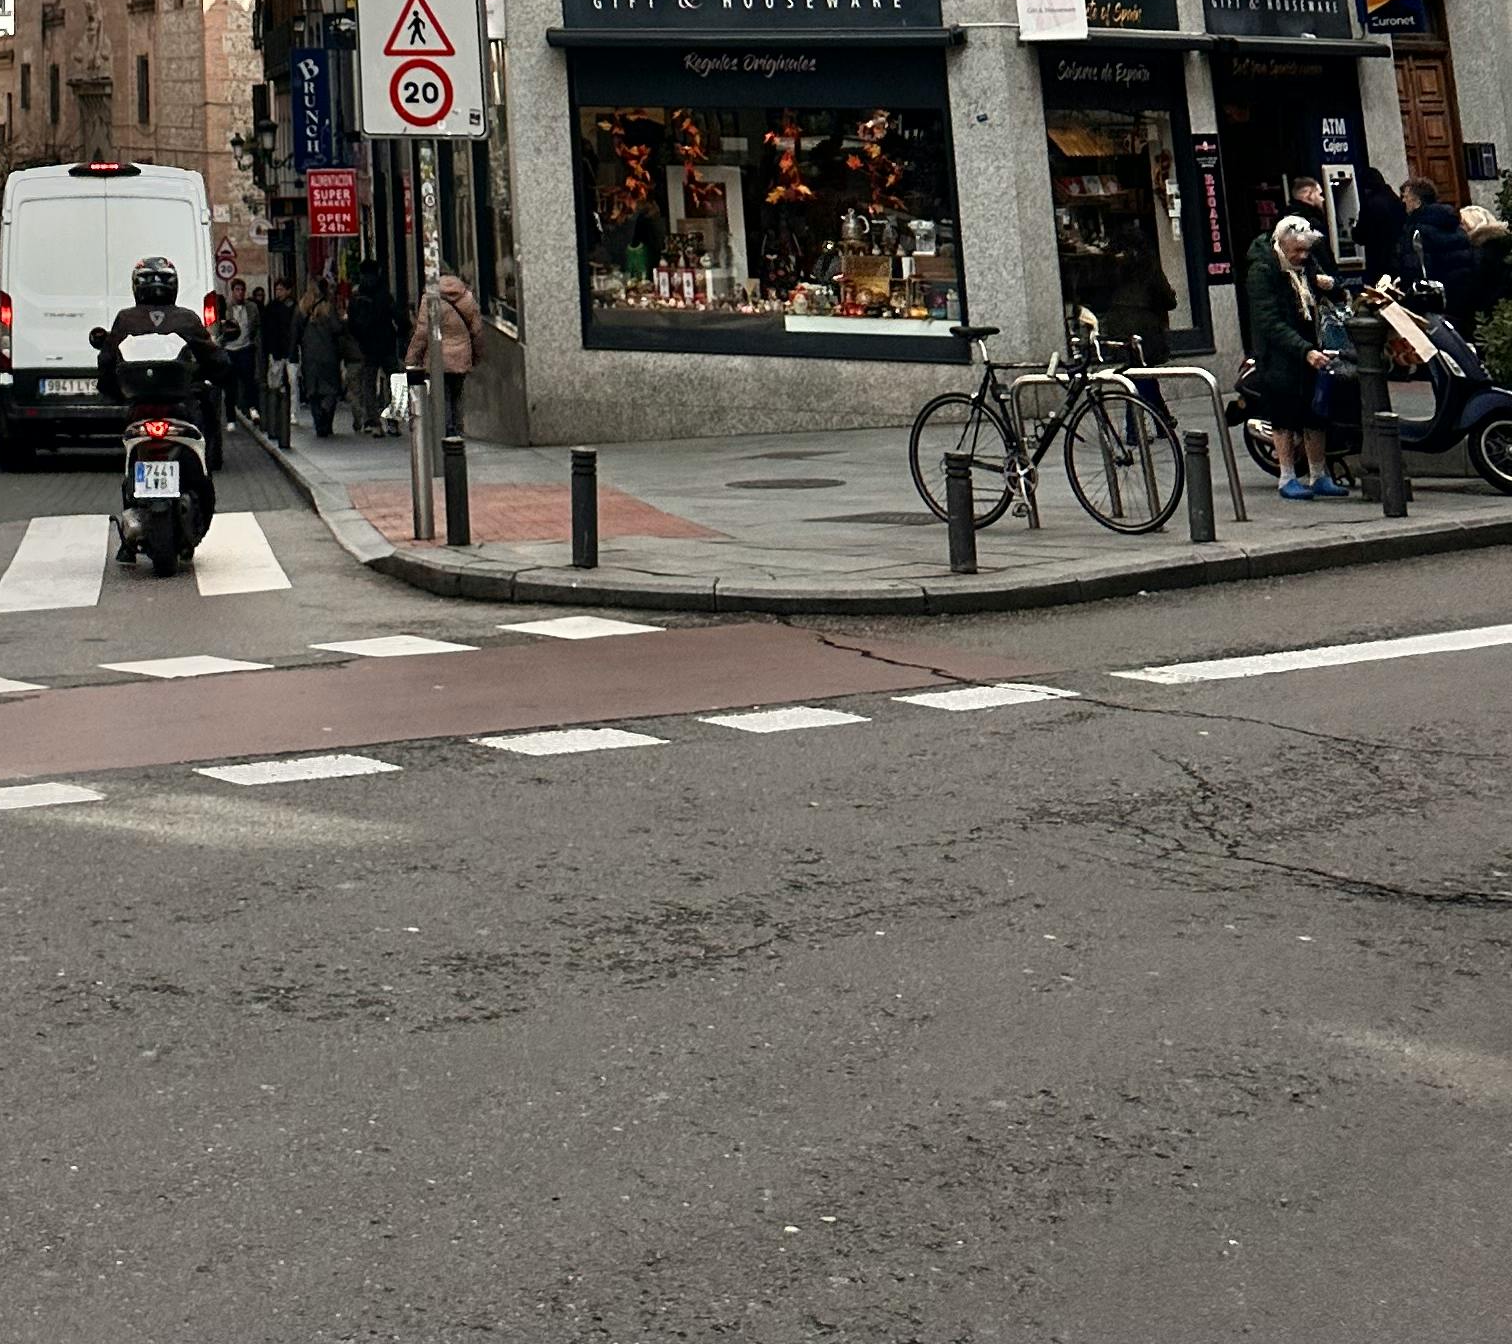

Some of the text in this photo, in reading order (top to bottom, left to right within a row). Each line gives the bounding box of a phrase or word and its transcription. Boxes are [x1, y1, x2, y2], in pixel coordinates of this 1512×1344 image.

[1268, 0, 1338, 13] HOUSEWARE
[1372, 16, 1416, 26] Euronet
[744, 53, 816, 79] Originales
[404, 82, 438, 103] 20
[297, 58, 320, 153] BRUNCH
[1322, 118, 1346, 136] ATM
[1323, 138, 1349, 155] Cajero
[313, 189, 351, 200] SUPER
[317, 213, 351, 223] OPEN
[1204, 173, 1221, 253] REGALOS
